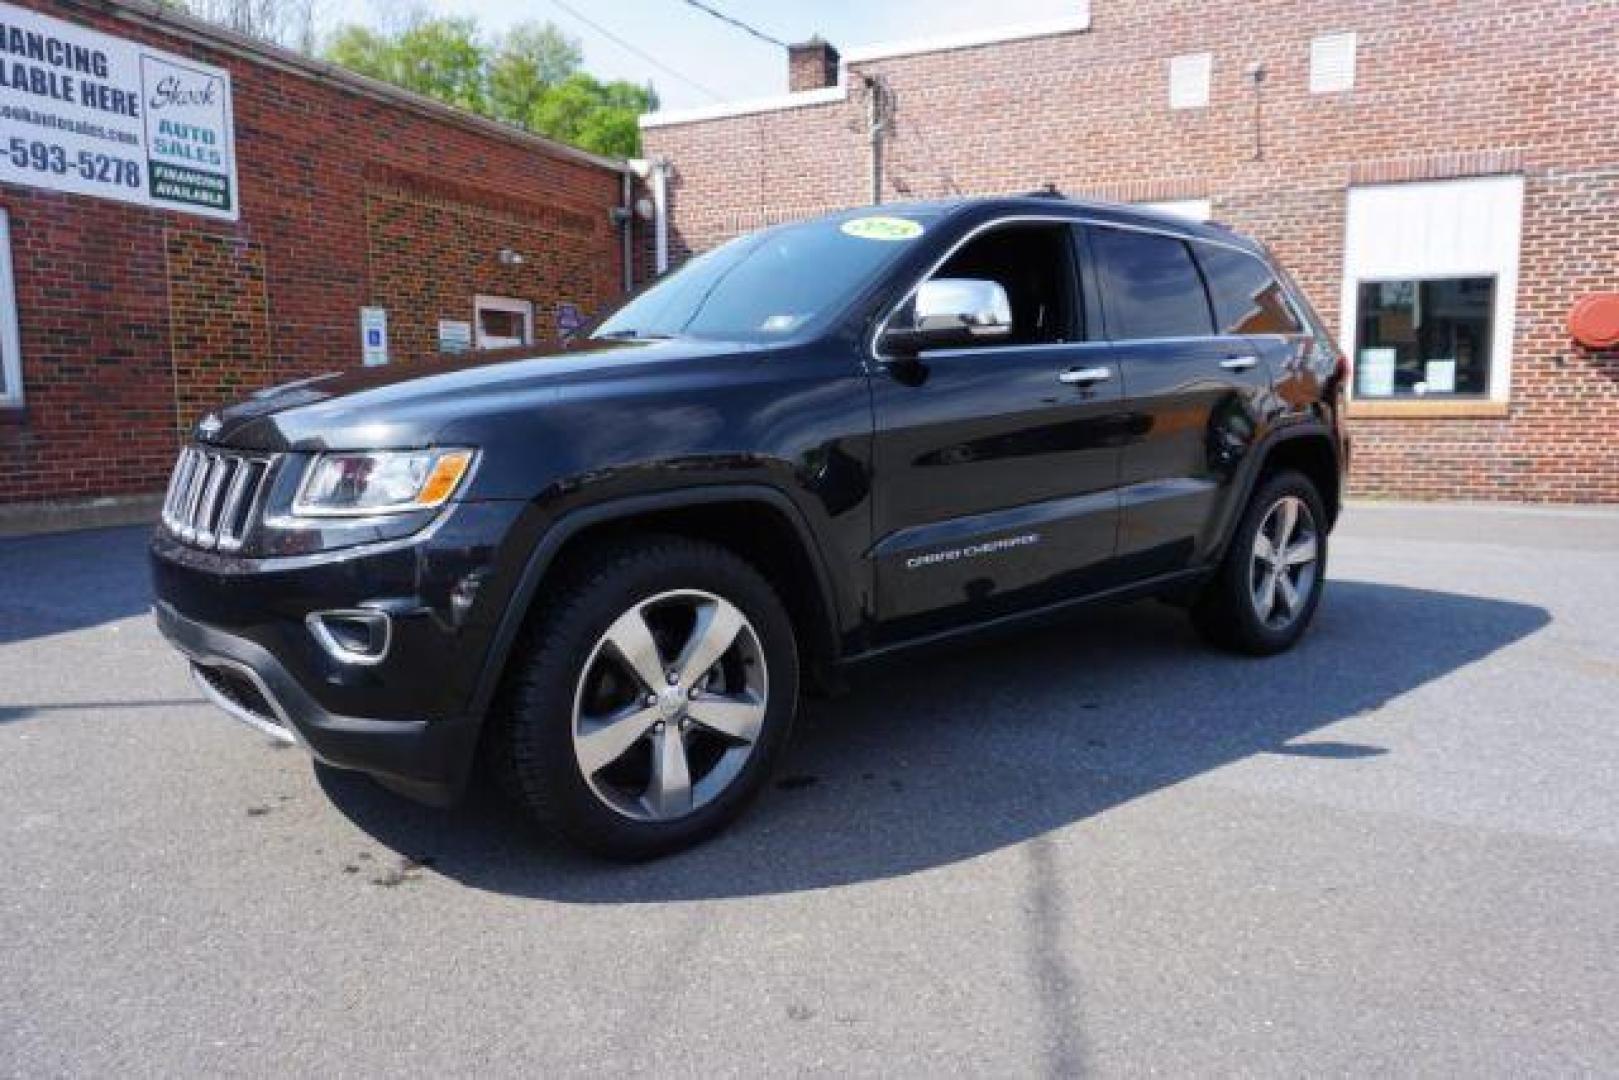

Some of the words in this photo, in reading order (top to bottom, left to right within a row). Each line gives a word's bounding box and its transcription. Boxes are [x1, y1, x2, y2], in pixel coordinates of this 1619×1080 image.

[80, 79, 140, 119] HERE
[158, 118, 216, 145] AUTO
[153, 137, 221, 165] SALES
